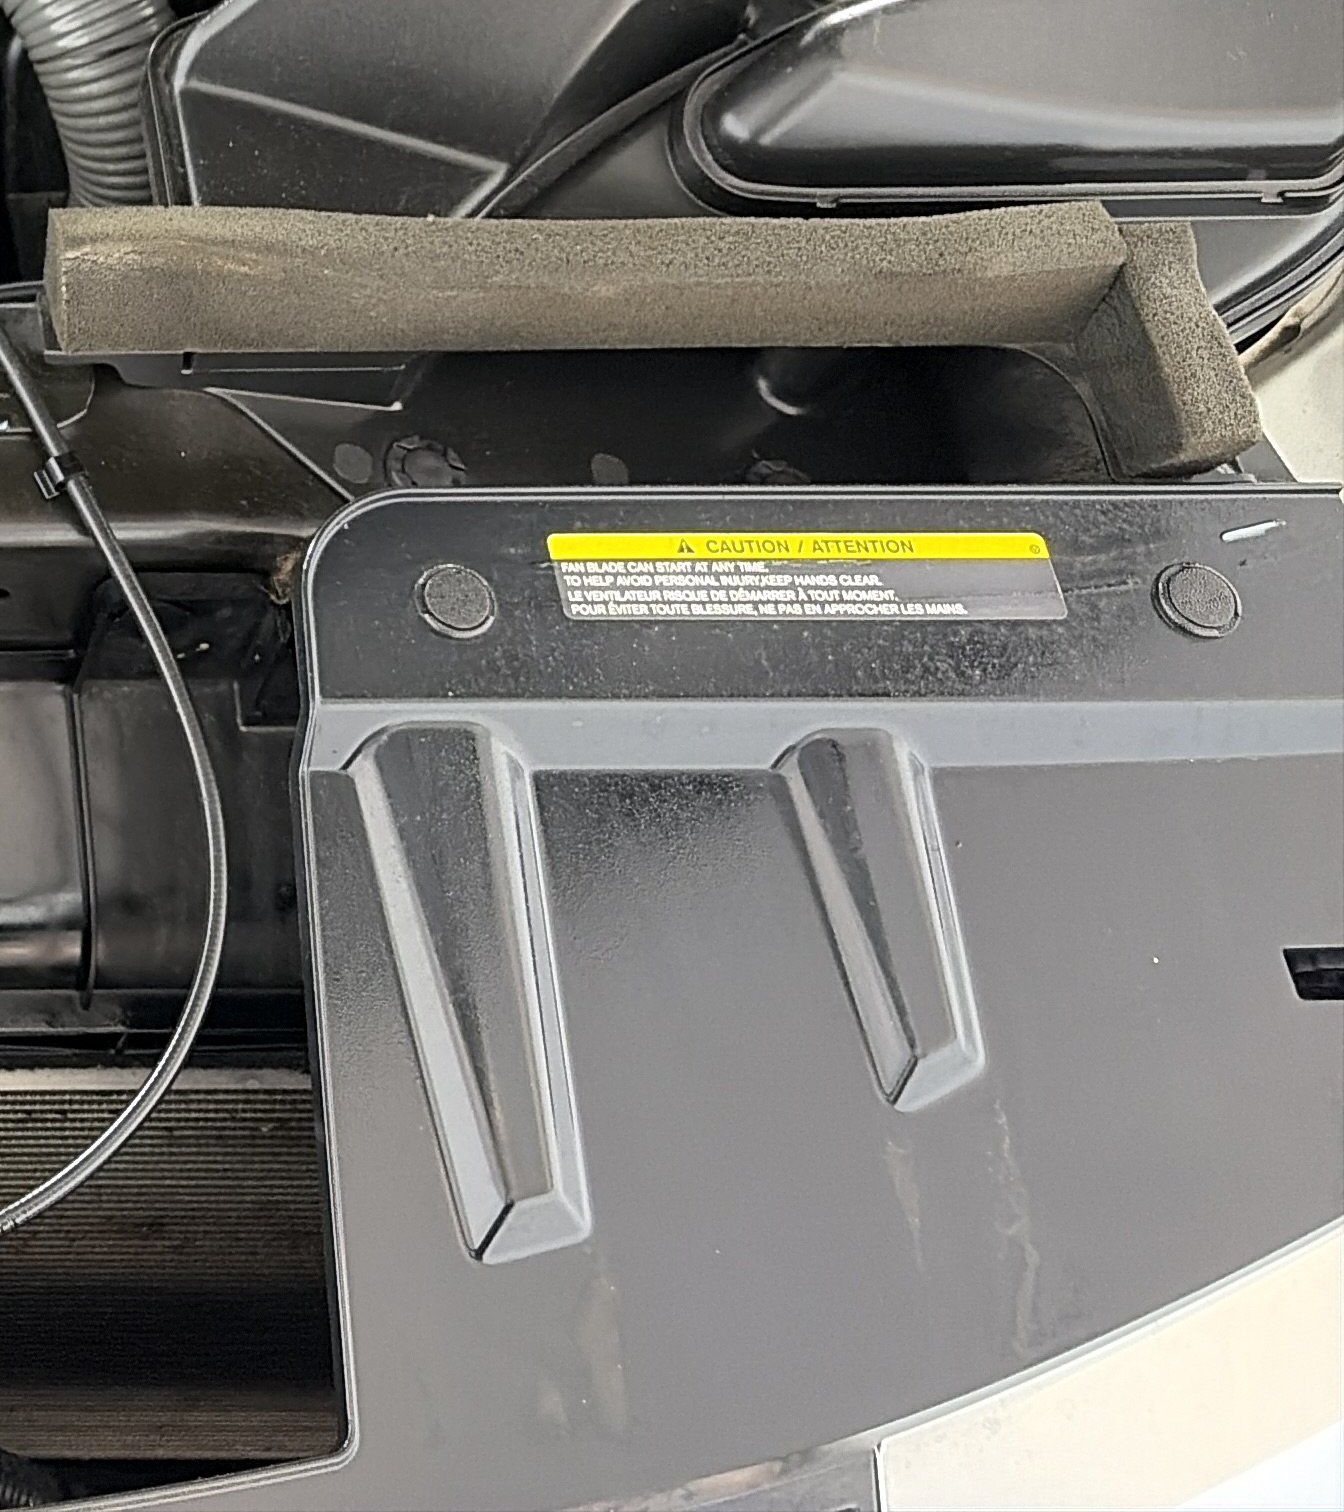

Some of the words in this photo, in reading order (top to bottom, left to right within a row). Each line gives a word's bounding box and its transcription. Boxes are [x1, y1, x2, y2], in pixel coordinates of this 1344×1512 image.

[705, 539, 791, 554] CAUTION
[811, 539, 915, 554] ATTENTION
[561, 561, 585, 573] FAN
[586, 561, 628, 573] BLADE
[629, 561, 654, 573] CAN
[656, 561, 694, 573] START
[694, 561, 709, 573] AT
[711, 561, 737, 573] ANY
[738, 561, 770, 573] TIME.
[564, 574, 581, 586] TO
[583, 574, 614, 586] HELP
[616, 574, 653, 586] AVOID
[654, 574, 720, 586] PERSONAL
[794, 574, 837, 586] HANDS
[839, 574, 883, 586] CLEAR.
[567, 590, 584, 601] LE
[584, 590, 662, 601] VENTILATEUR
[663, 590, 708, 602] RISQUE
[711, 590, 727, 601] DE
[730, 587, 796, 601] DÉMARRER
[809, 589, 841, 601] TOUT
[842, 589, 899, 601] MOMENT.
[571, 603, 608, 615] POUR
[608, 601, 649, 615] ÉVITER
[649, 603, 691, 615] TOUTE
[759, 603, 777, 615] NE
[778, 603, 804, 615] PAS
[805, 603, 823, 615] EN
[823, 603, 900, 615] APPROCHER
[902, 603, 925, 615] LES
[926, 603, 968, 615] MAINS.
